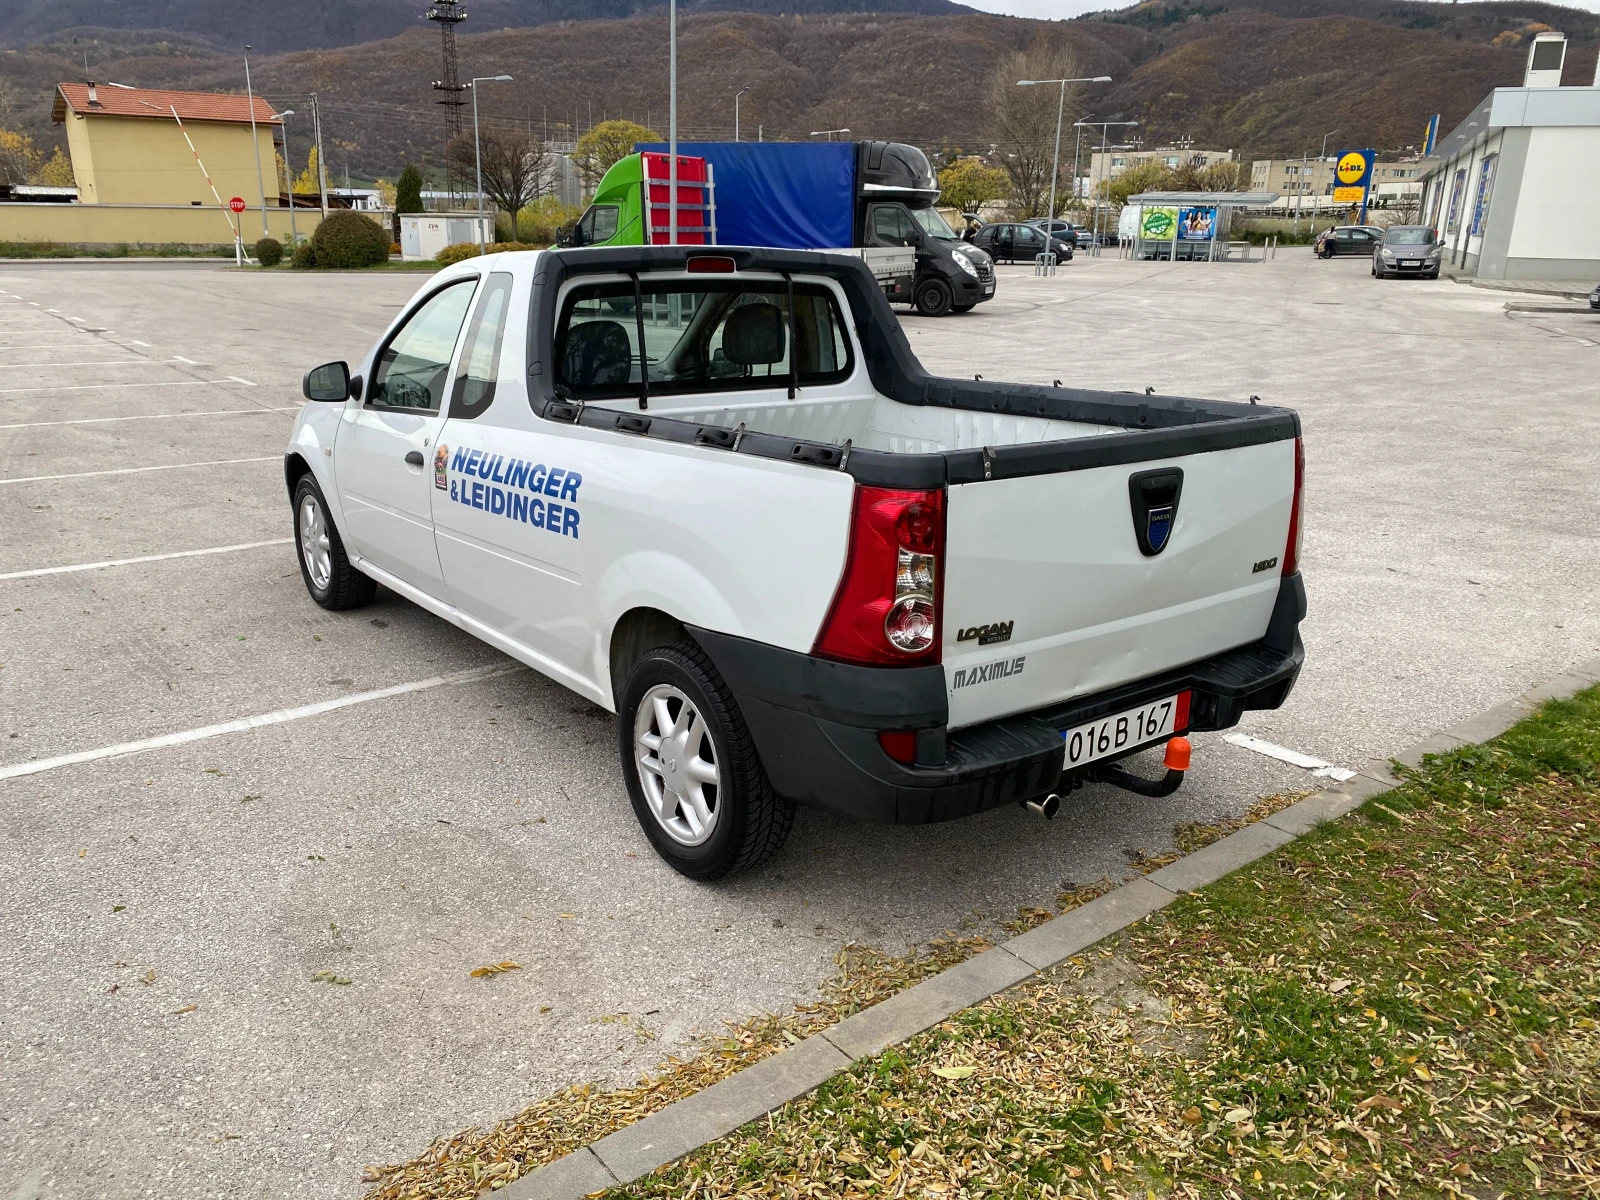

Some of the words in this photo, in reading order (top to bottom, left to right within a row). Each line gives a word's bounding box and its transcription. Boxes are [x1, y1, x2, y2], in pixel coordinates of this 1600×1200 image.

[230, 201, 245, 209] STOP
[451, 446, 583, 503] NEULINGER
[450, 479, 459, 502] &
[461, 479, 581, 539] LEIDINGER
[1151, 513, 1171, 522] DACIA
[956, 620, 1014, 642] LOGAN
[953, 656, 1026, 689] MAXIMUS
